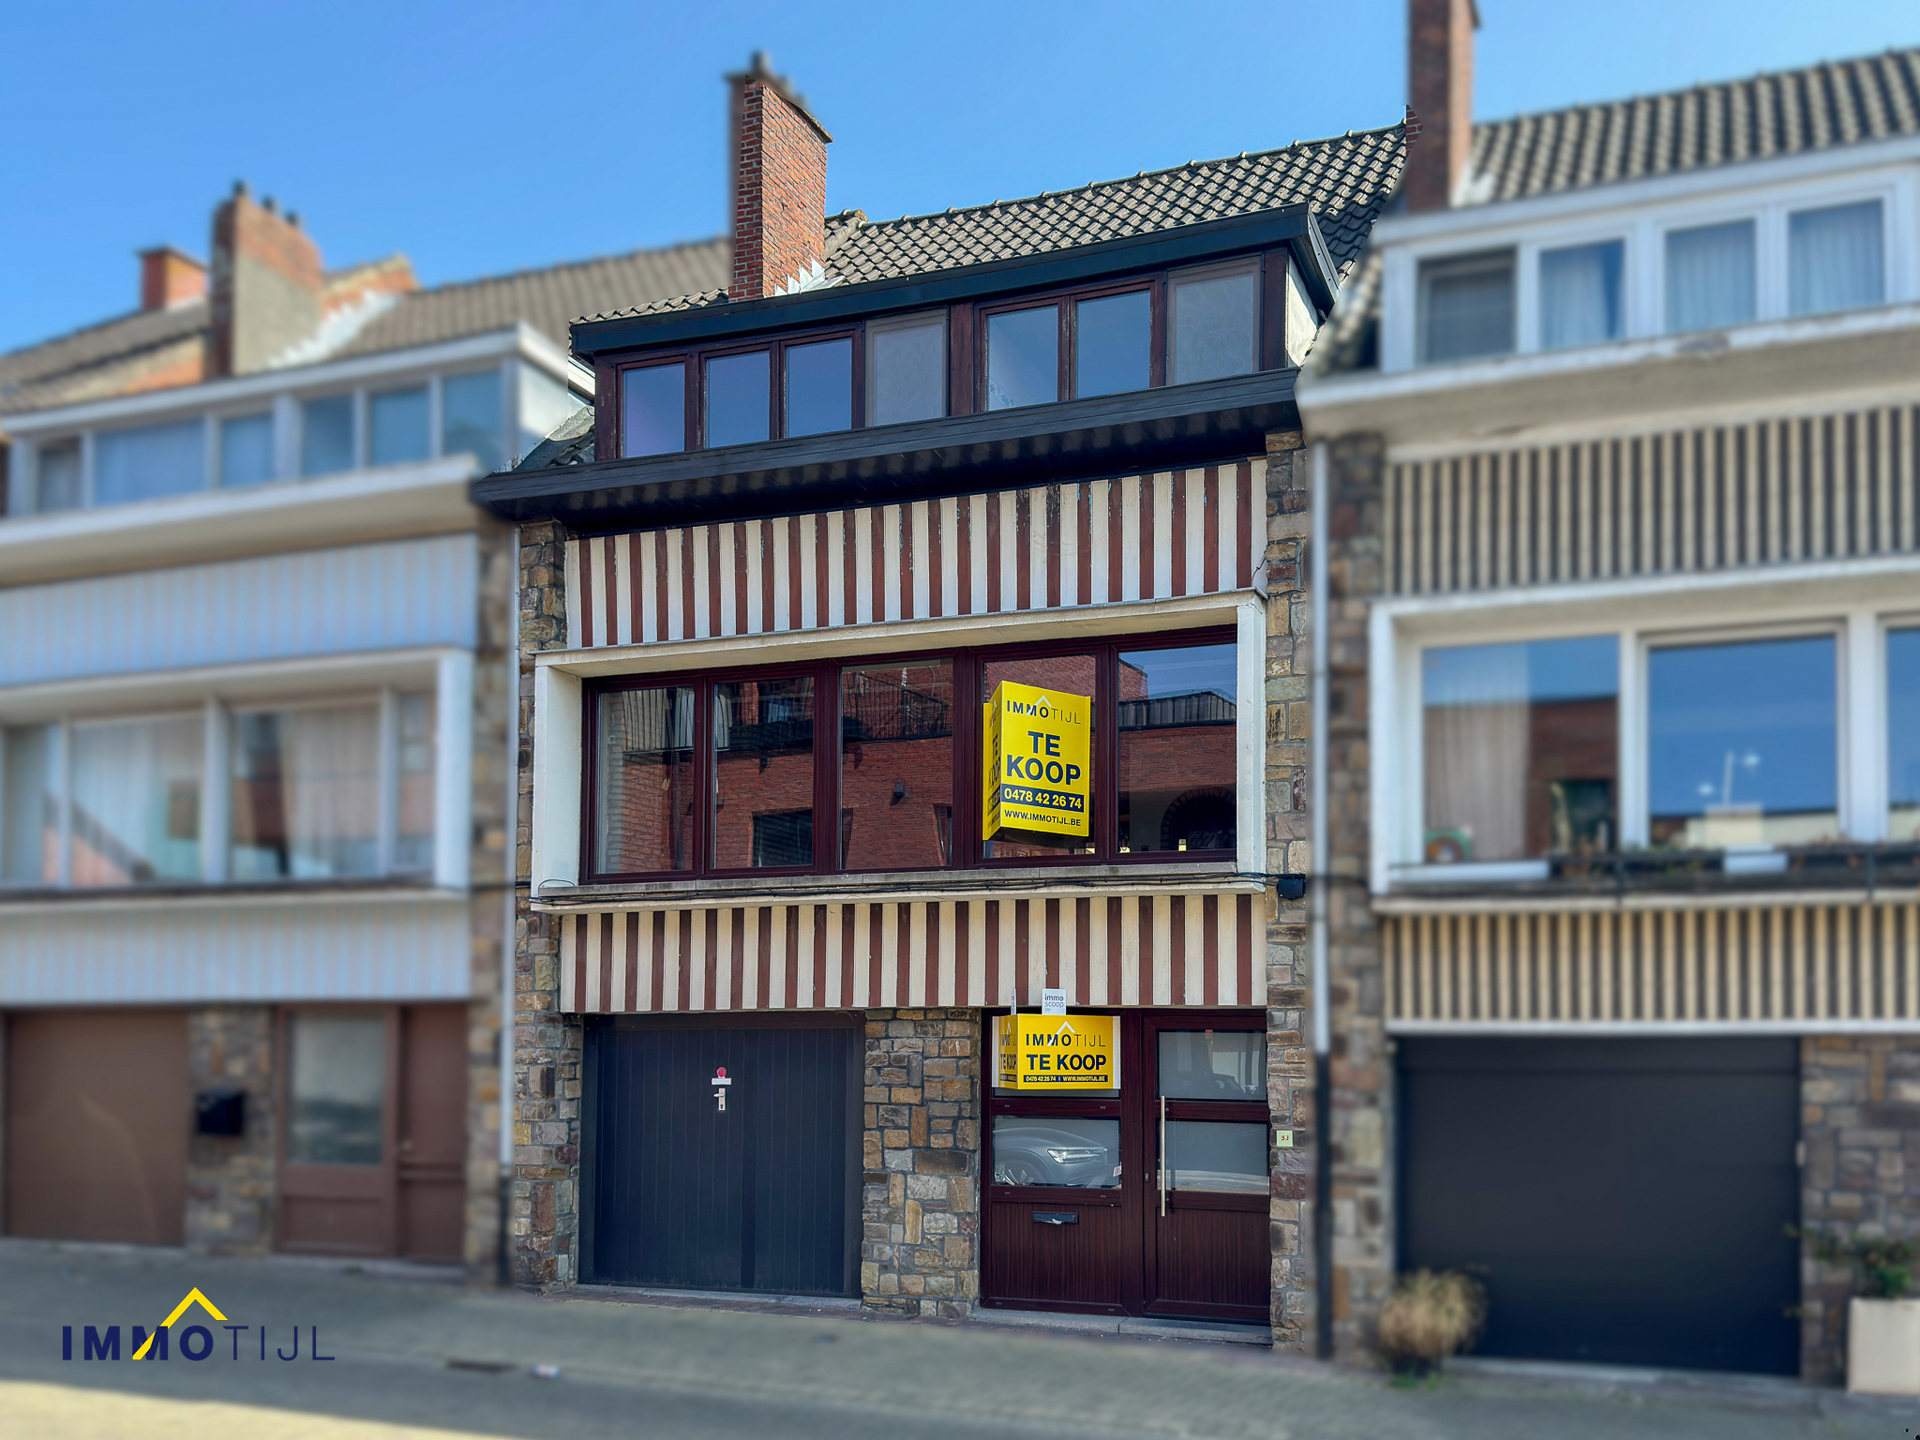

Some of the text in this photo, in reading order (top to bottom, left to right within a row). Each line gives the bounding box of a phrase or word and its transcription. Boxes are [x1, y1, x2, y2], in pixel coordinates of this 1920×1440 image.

[1027, 730, 1061, 757] TE
[1006, 754, 1081, 786] KOOP
[1004, 787, 1033, 803] 0478
[1035, 792, 1050, 805] 42
[1052, 794, 1067, 807] 26
[1068, 796, 1082, 809] 74
[1004, 809, 1082, 827] WWW.IMMOTIJL.BE
[1026, 1054, 1107, 1071] TE KOOP
